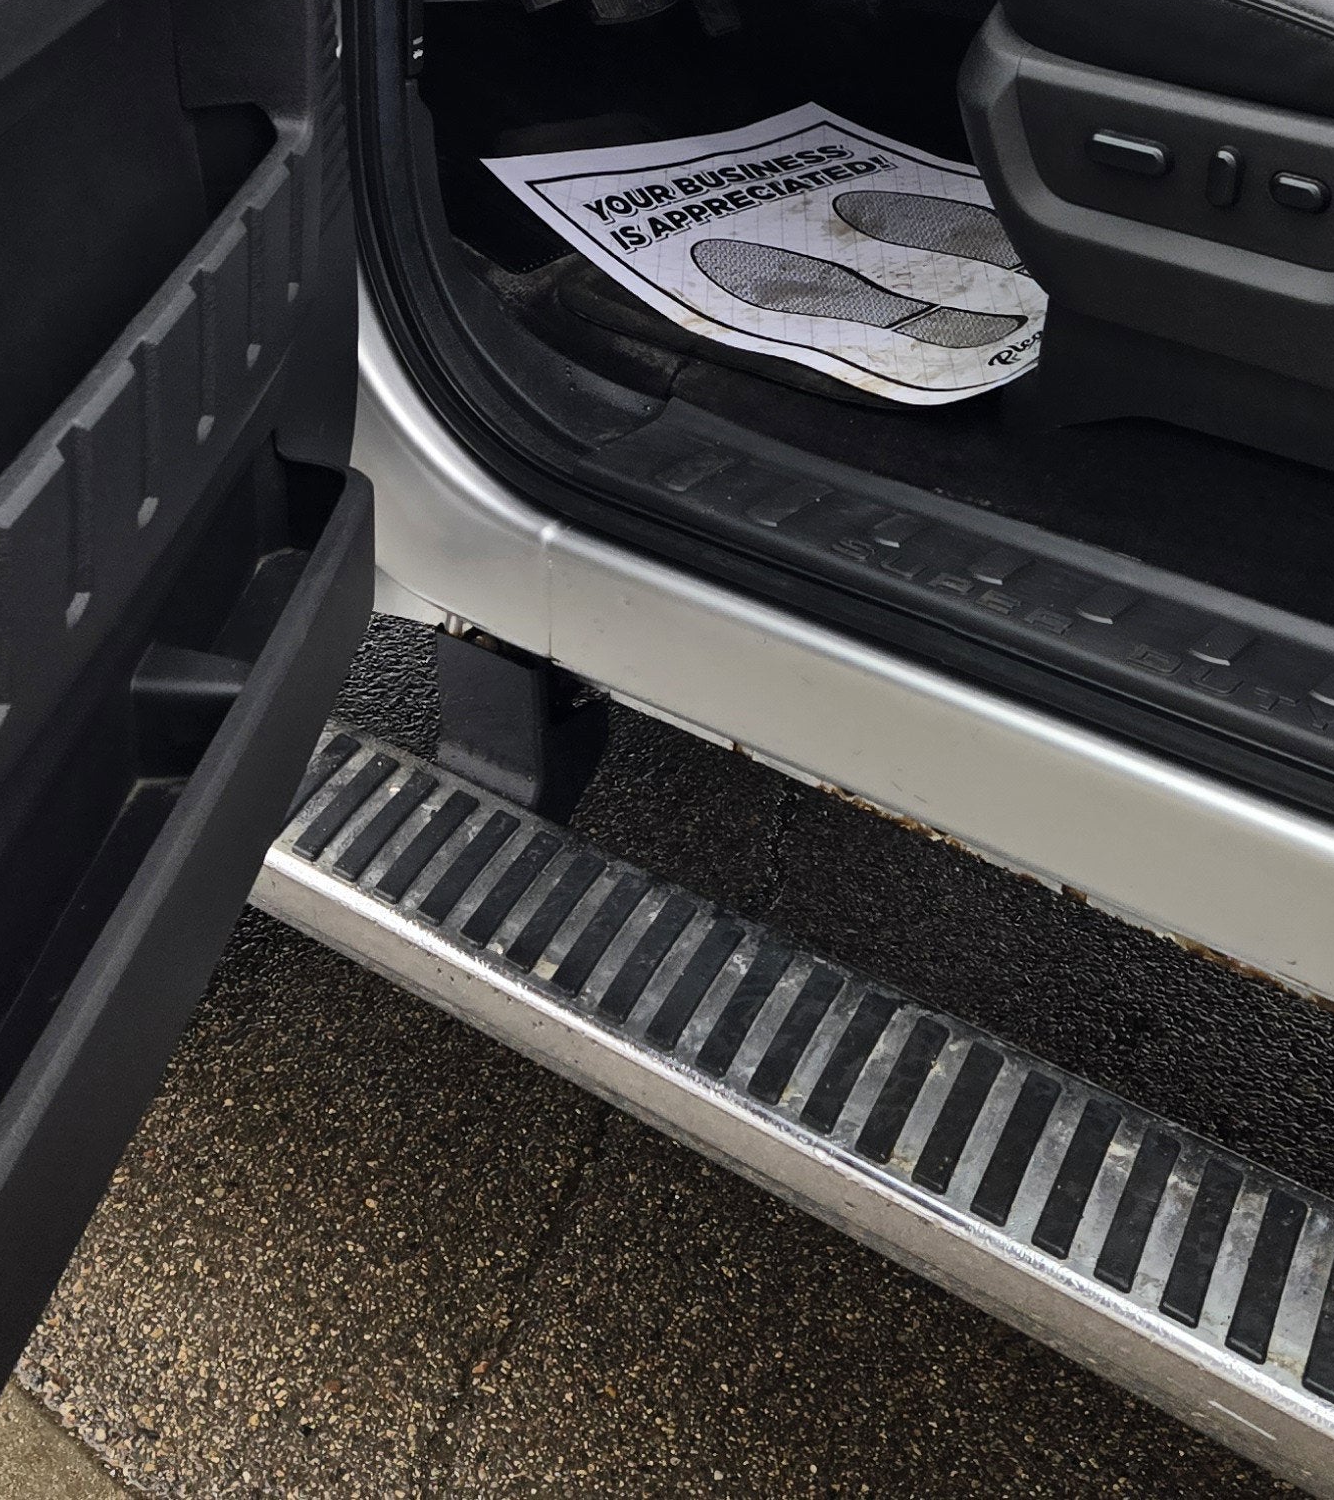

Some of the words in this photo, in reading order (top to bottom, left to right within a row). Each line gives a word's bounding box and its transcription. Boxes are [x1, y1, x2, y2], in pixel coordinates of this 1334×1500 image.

[582, 184, 678, 225] YOUR
[669, 144, 854, 198] BUSINESS
[609, 223, 653, 255] IS
[830, 536, 1074, 636] SUPER
